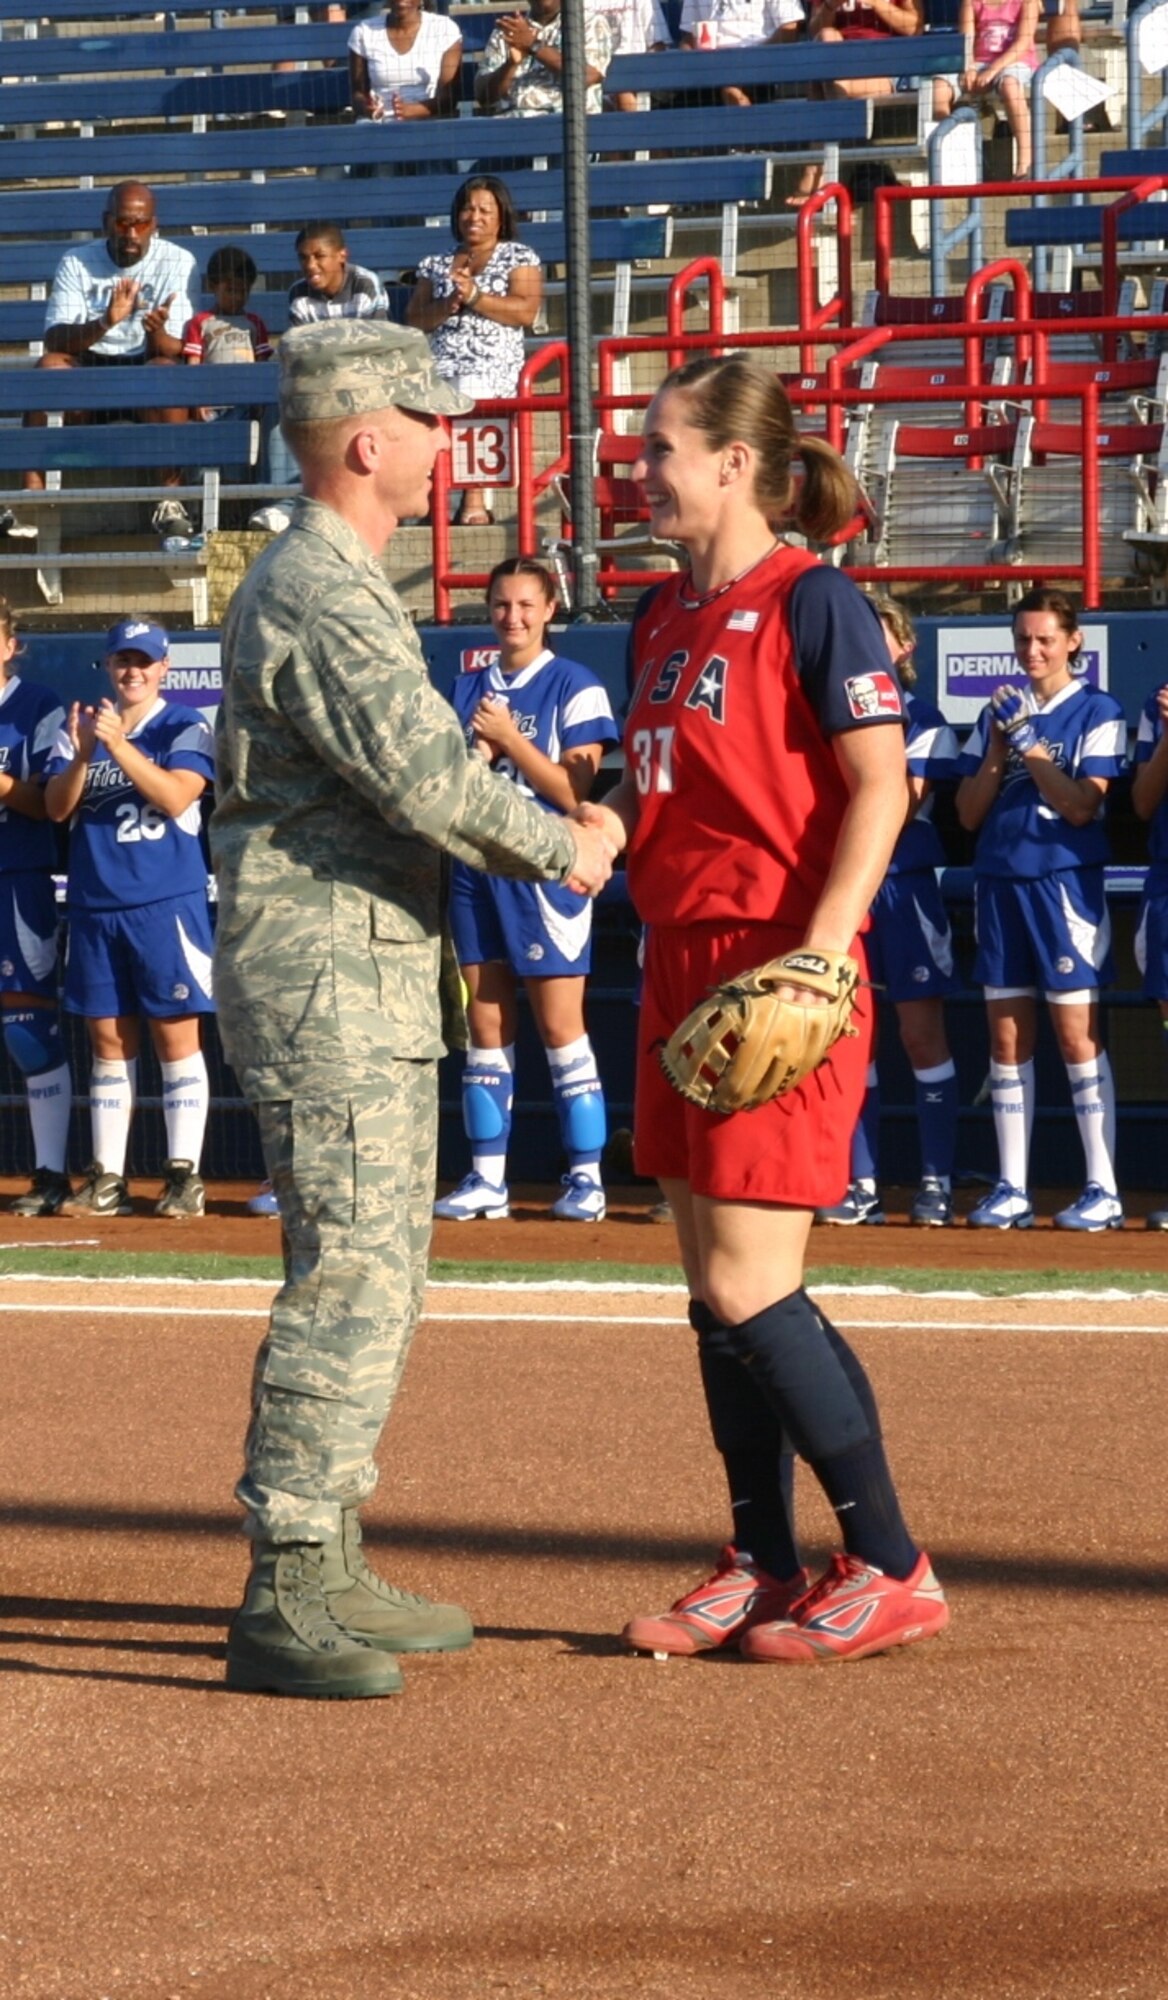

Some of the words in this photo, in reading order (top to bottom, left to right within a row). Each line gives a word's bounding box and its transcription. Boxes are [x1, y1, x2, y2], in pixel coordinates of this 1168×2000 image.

[457, 426, 506, 475] 13
[632, 726, 675, 794] 37
[115, 802, 166, 842] 26
